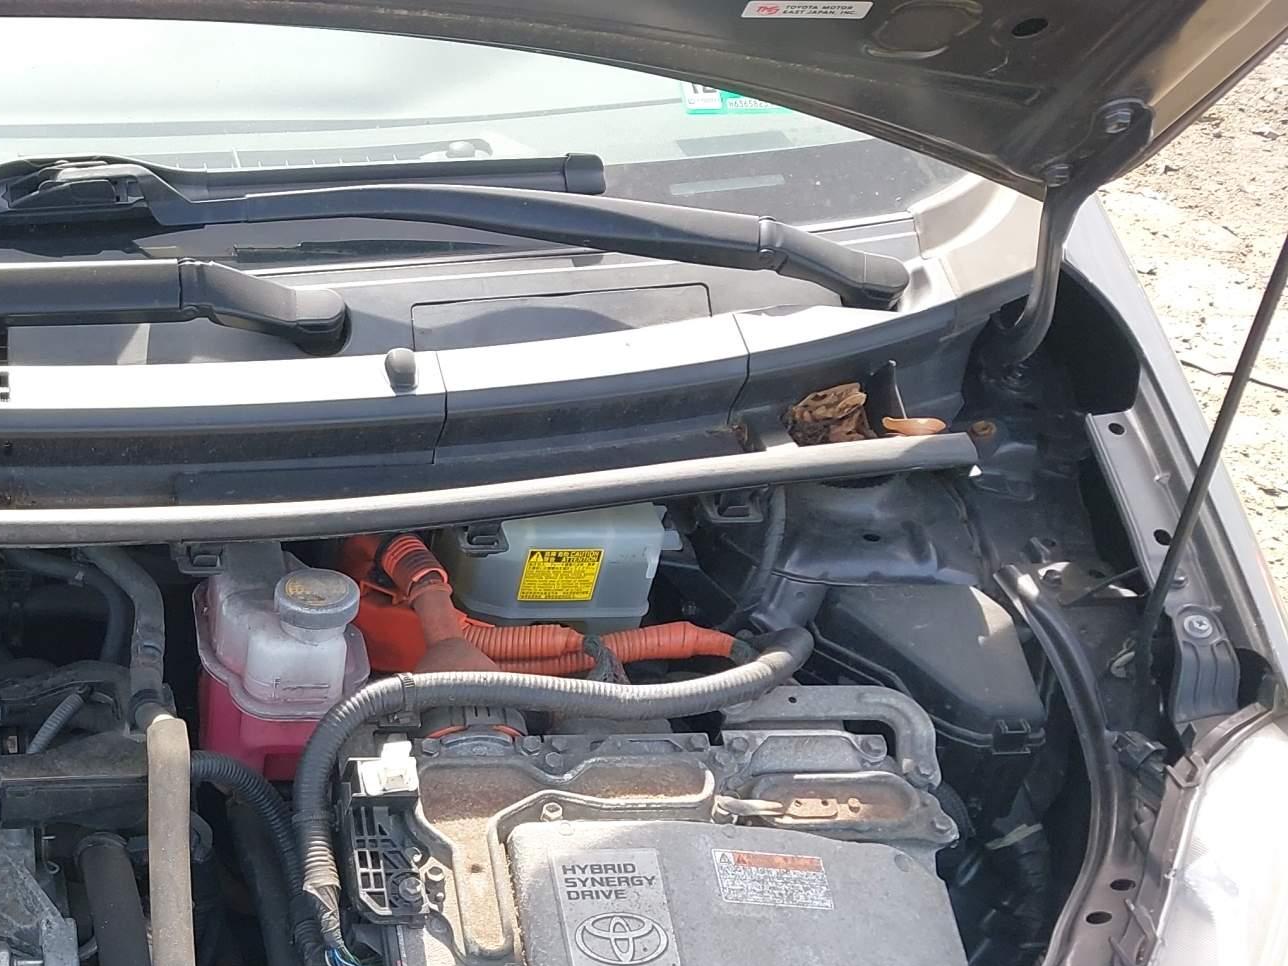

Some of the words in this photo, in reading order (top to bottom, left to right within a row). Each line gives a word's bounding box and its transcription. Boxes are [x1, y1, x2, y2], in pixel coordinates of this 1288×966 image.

[562, 863, 637, 875] HYBRID
[564, 875, 656, 888] SYNERGY
[566, 889, 628, 901] DRIVE
